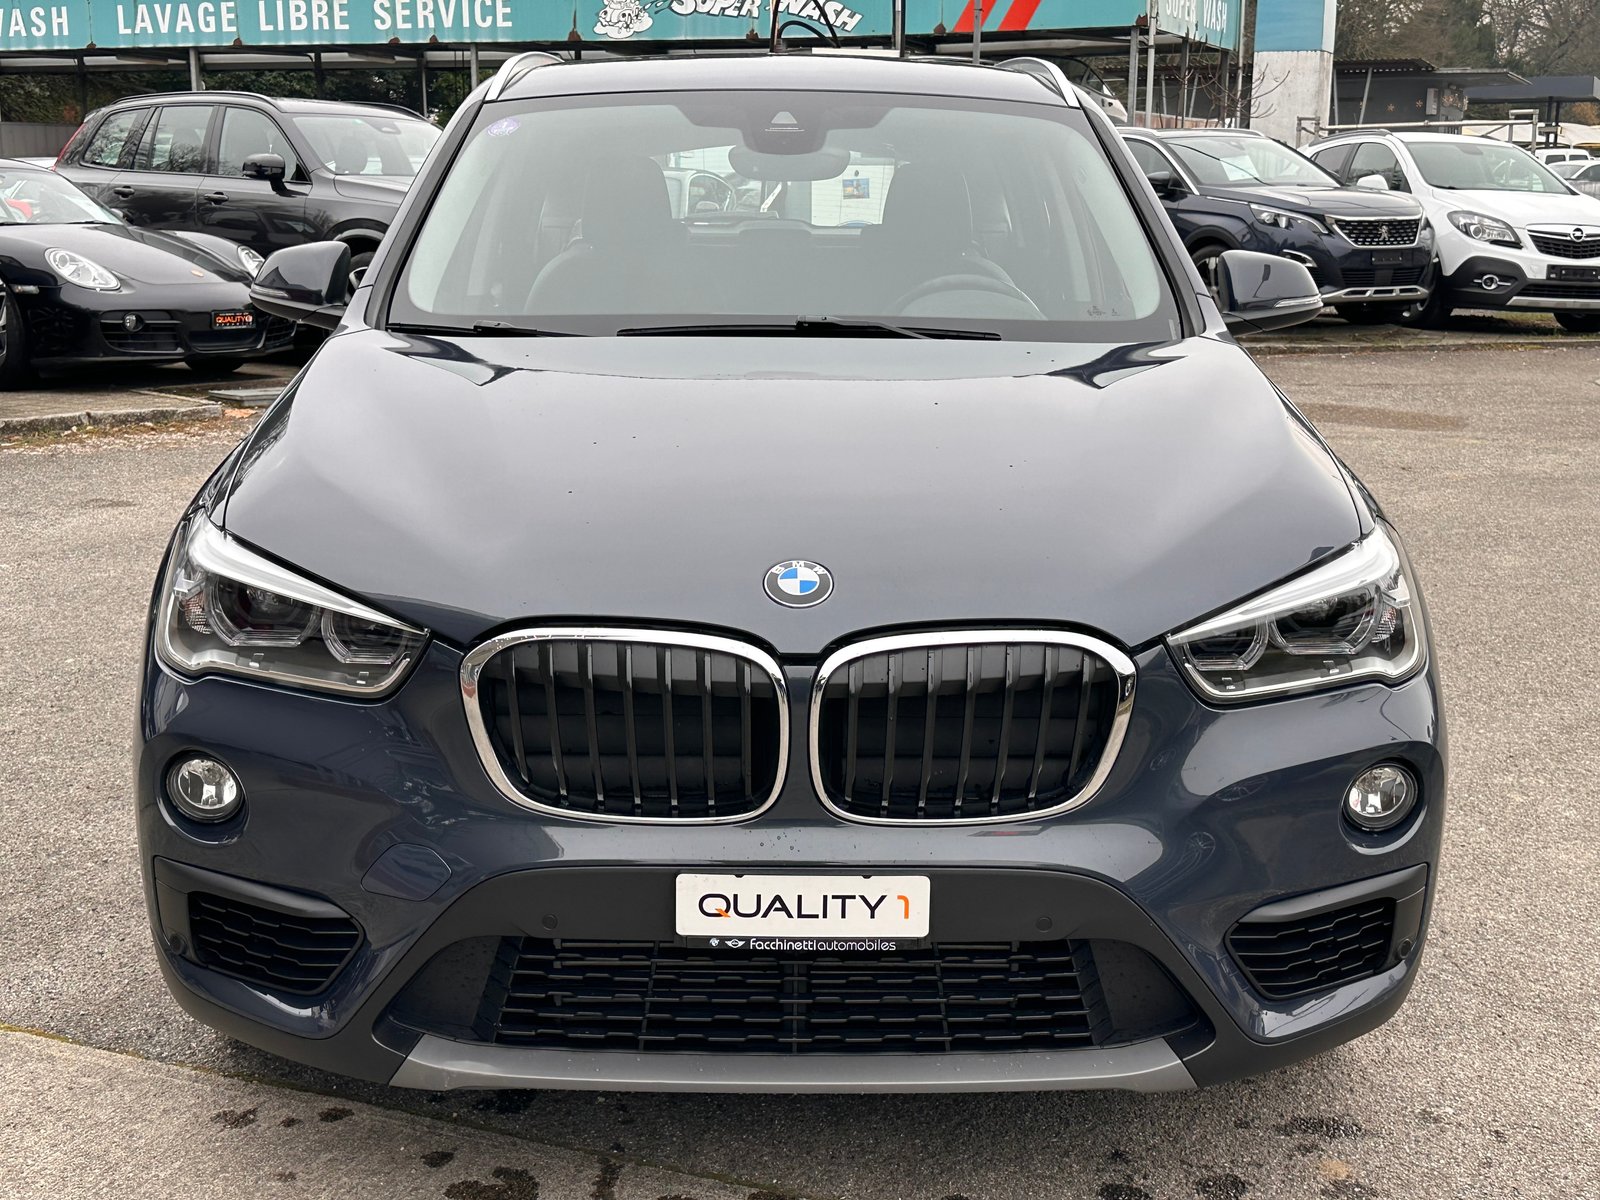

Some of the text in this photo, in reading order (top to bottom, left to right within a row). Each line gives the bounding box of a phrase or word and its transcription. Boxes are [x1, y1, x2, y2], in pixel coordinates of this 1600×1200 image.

[0, 6, 69, 37] ASH
[117, 0, 513, 34] LAVAGE LIBRE SERVICE
[777, 0, 863, 32] WASH
[1203, 0, 1228, 33] WASH
[771, 560, 827, 575] BMW
[698, 893, 910, 919] QUALITY 1
